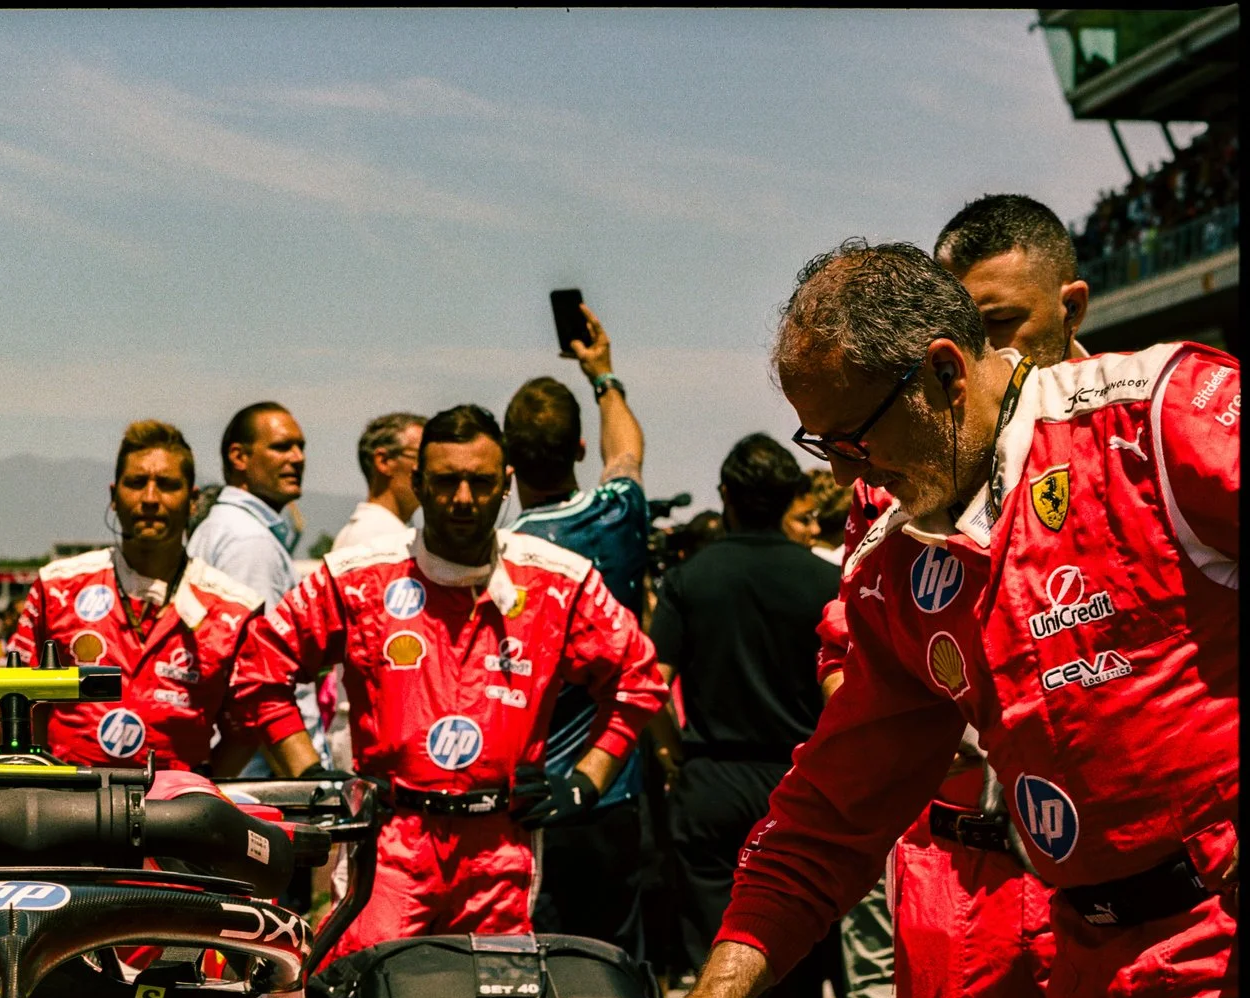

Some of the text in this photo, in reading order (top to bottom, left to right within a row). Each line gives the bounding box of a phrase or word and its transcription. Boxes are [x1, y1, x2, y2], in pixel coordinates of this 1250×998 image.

[1215, 386, 1241, 427] bre
[387, 578, 424, 619] hp
[916, 545, 958, 612] hp
[1031, 592, 1113, 638] UniCredit
[1083, 667, 1131, 686] LOGISTICS
[100, 708, 143, 757] hp
[431, 717, 479, 769] hp
[479, 983, 539, 995] SET 40
